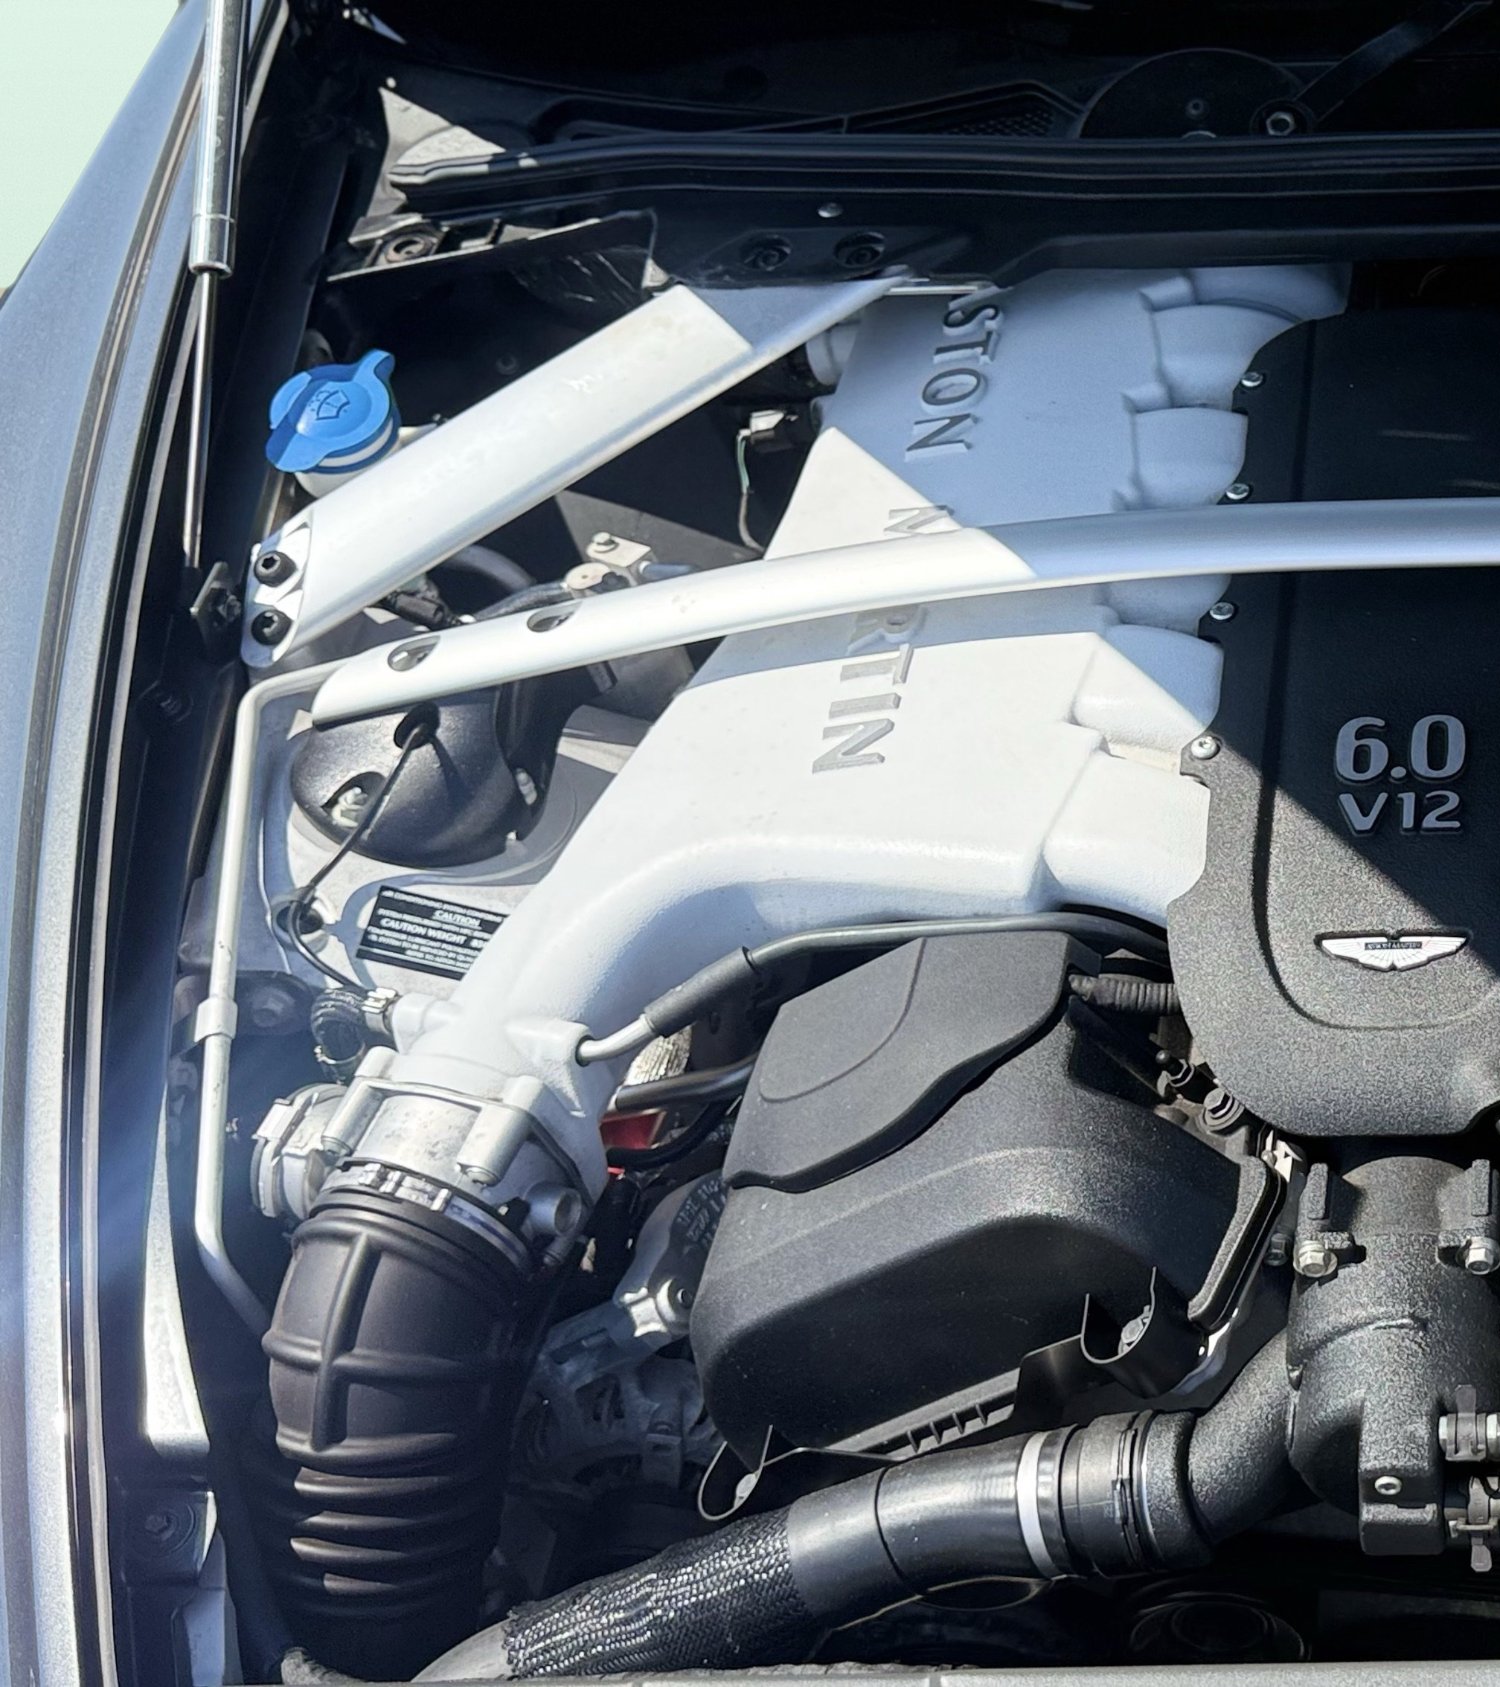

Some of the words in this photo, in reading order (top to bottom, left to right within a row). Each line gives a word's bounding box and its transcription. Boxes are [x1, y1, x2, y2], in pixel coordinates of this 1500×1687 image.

[905, 288, 1003, 458] STON
[1335, 713, 1467, 782] 6.0
[1337, 789, 1463, 833] V12
[380, 917, 427, 935] CAUTION
[427, 927, 468, 945] WEIGHT
[433, 909, 481, 927] CAUTION
